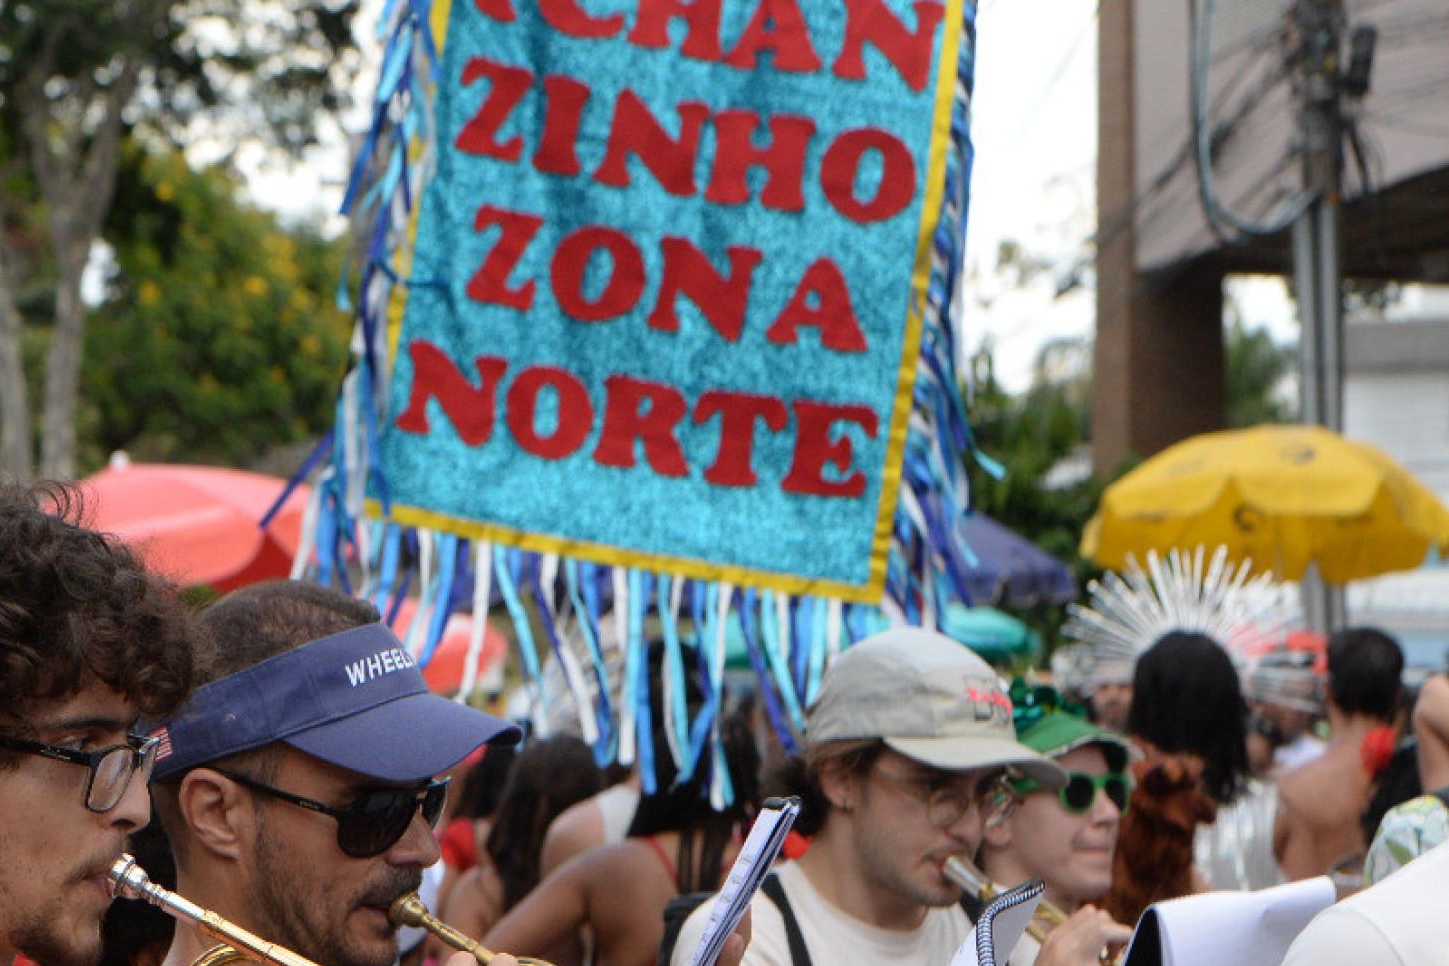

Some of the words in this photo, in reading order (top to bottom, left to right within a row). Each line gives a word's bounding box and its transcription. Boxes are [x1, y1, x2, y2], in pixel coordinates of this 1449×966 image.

[476, 0, 947, 91] HAN
[455, 58, 916, 223] ZINHO
[467, 205, 867, 352] ZONA
[396, 341, 878, 497] NORTE
